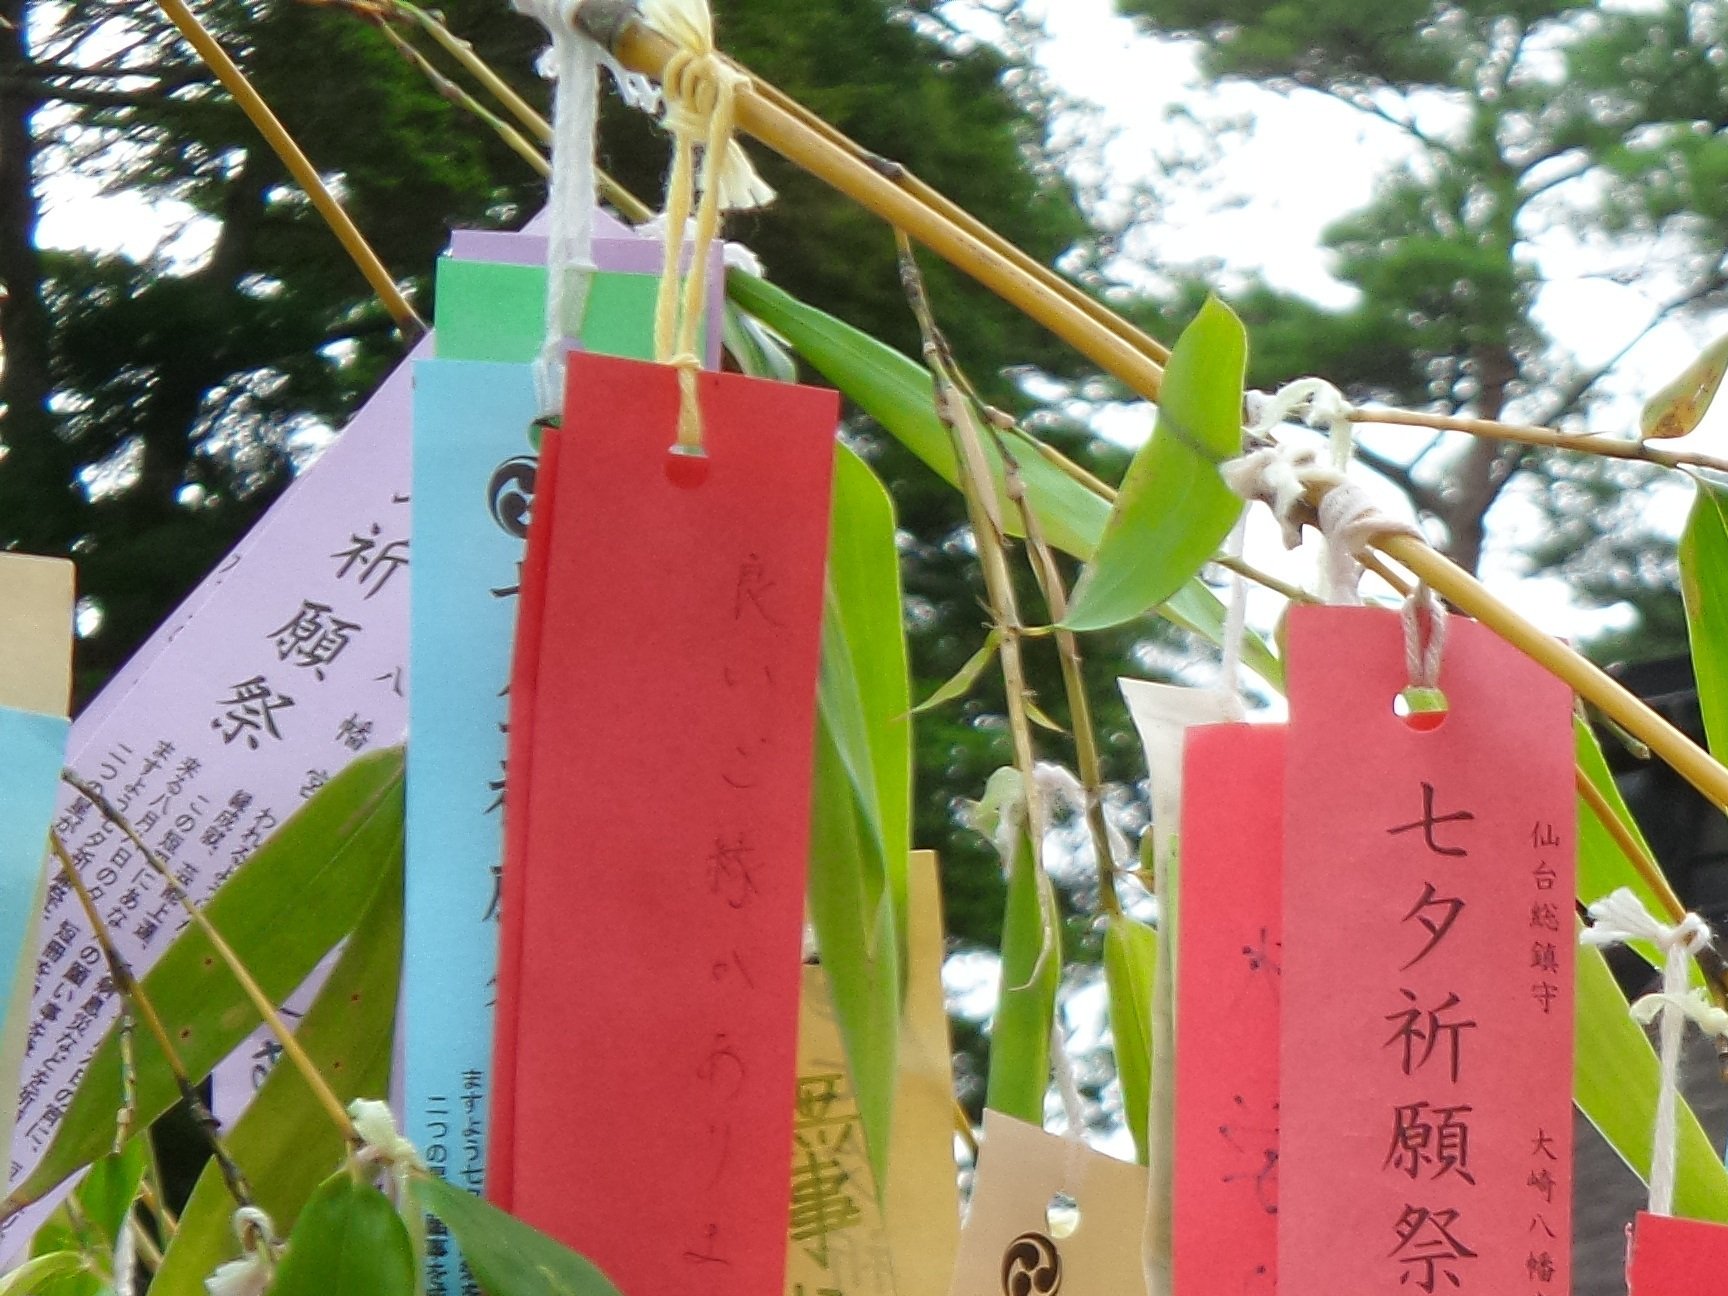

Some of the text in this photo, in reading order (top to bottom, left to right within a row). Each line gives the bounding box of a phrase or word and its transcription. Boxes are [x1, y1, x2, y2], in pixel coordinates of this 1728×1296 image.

[1383, 781, 1477, 1294] 七夕祈願祭
[1527, 820, 1560, 1014] 仙台総鎮守
